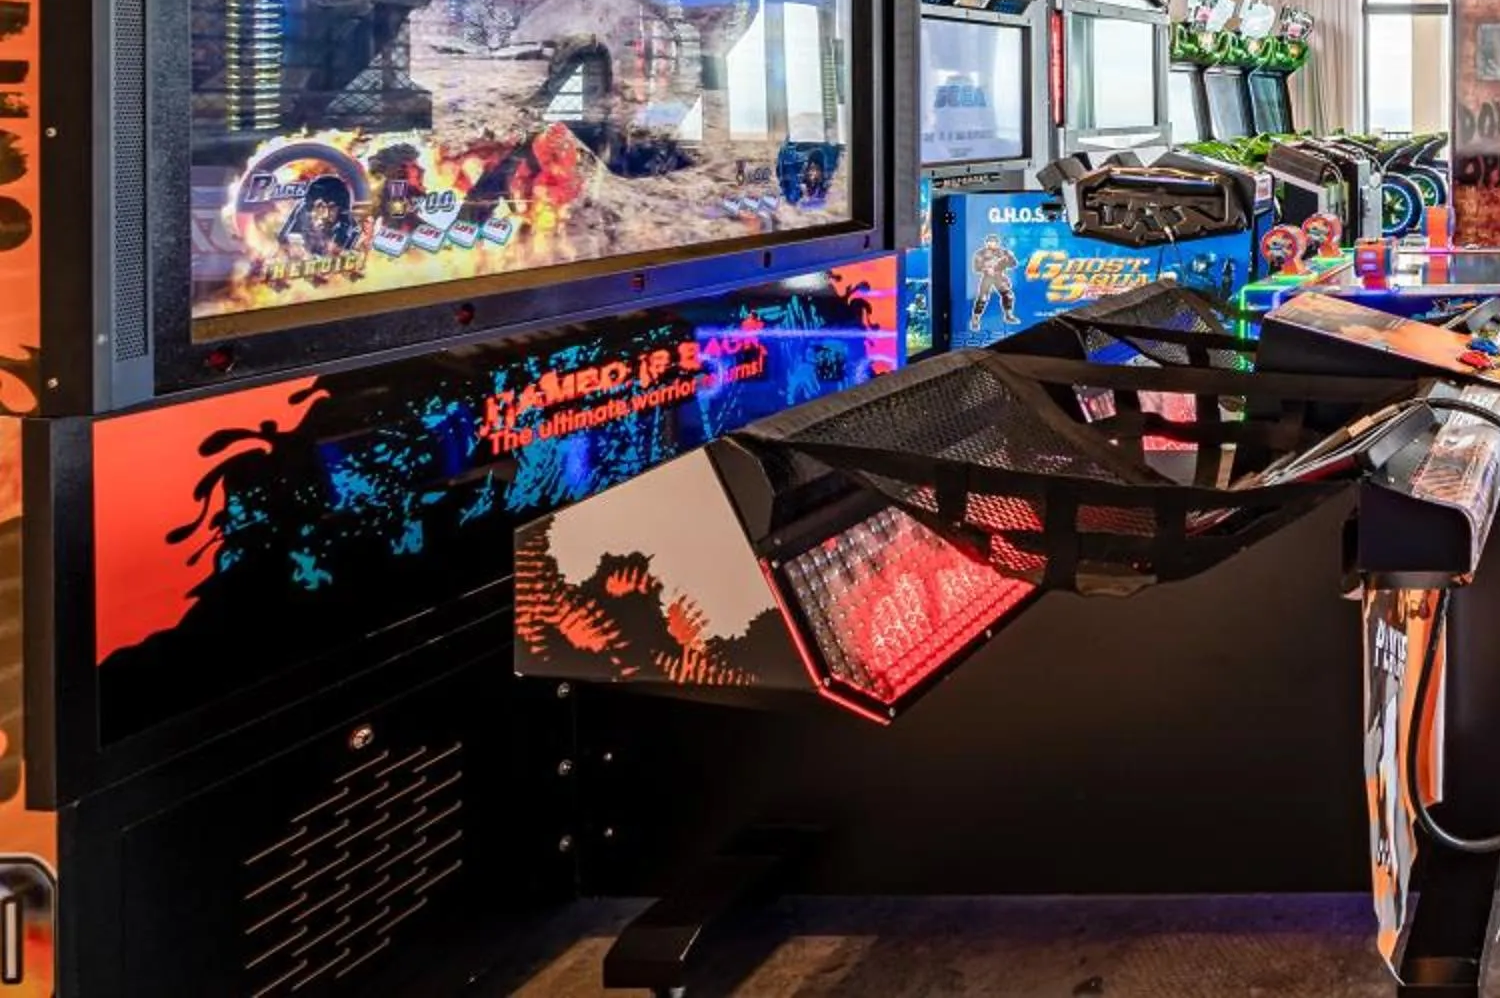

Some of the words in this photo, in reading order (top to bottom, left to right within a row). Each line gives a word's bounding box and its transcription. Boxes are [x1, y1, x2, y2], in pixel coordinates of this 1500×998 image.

[1045, 272, 1151, 302] SQUA
[490, 424, 533, 456] The
[539, 396, 629, 440] ultimate
[630, 375, 697, 414] warrior
